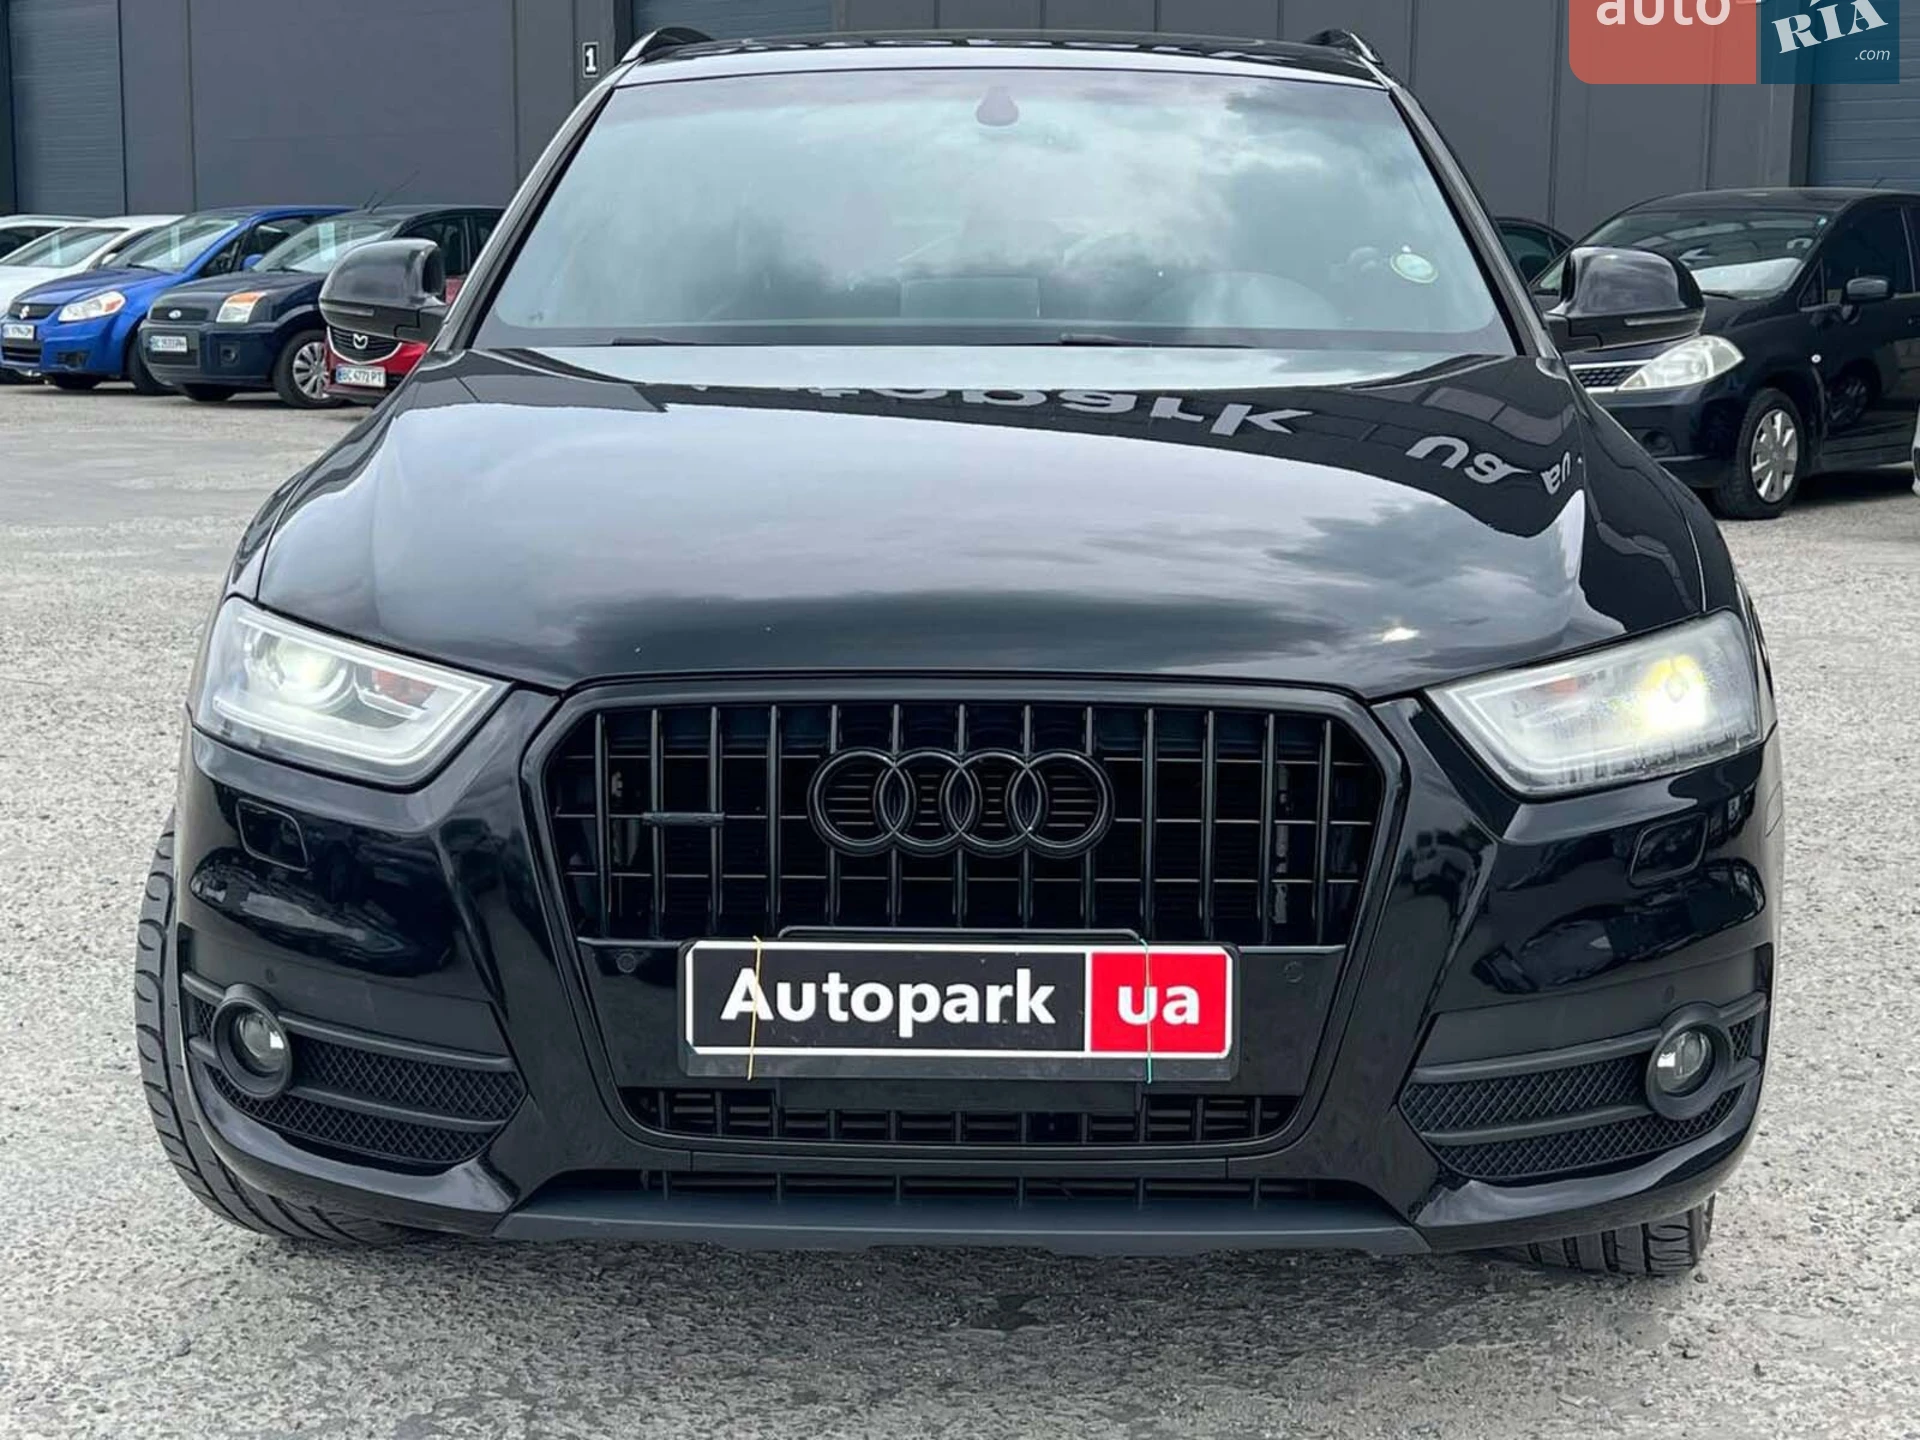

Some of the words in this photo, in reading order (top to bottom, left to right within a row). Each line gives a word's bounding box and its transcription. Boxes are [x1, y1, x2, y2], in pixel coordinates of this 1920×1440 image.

[585, 47, 597, 73] 1
[720, 968, 1056, 1038] Autopark
[1117, 985, 1199, 1025] ua
